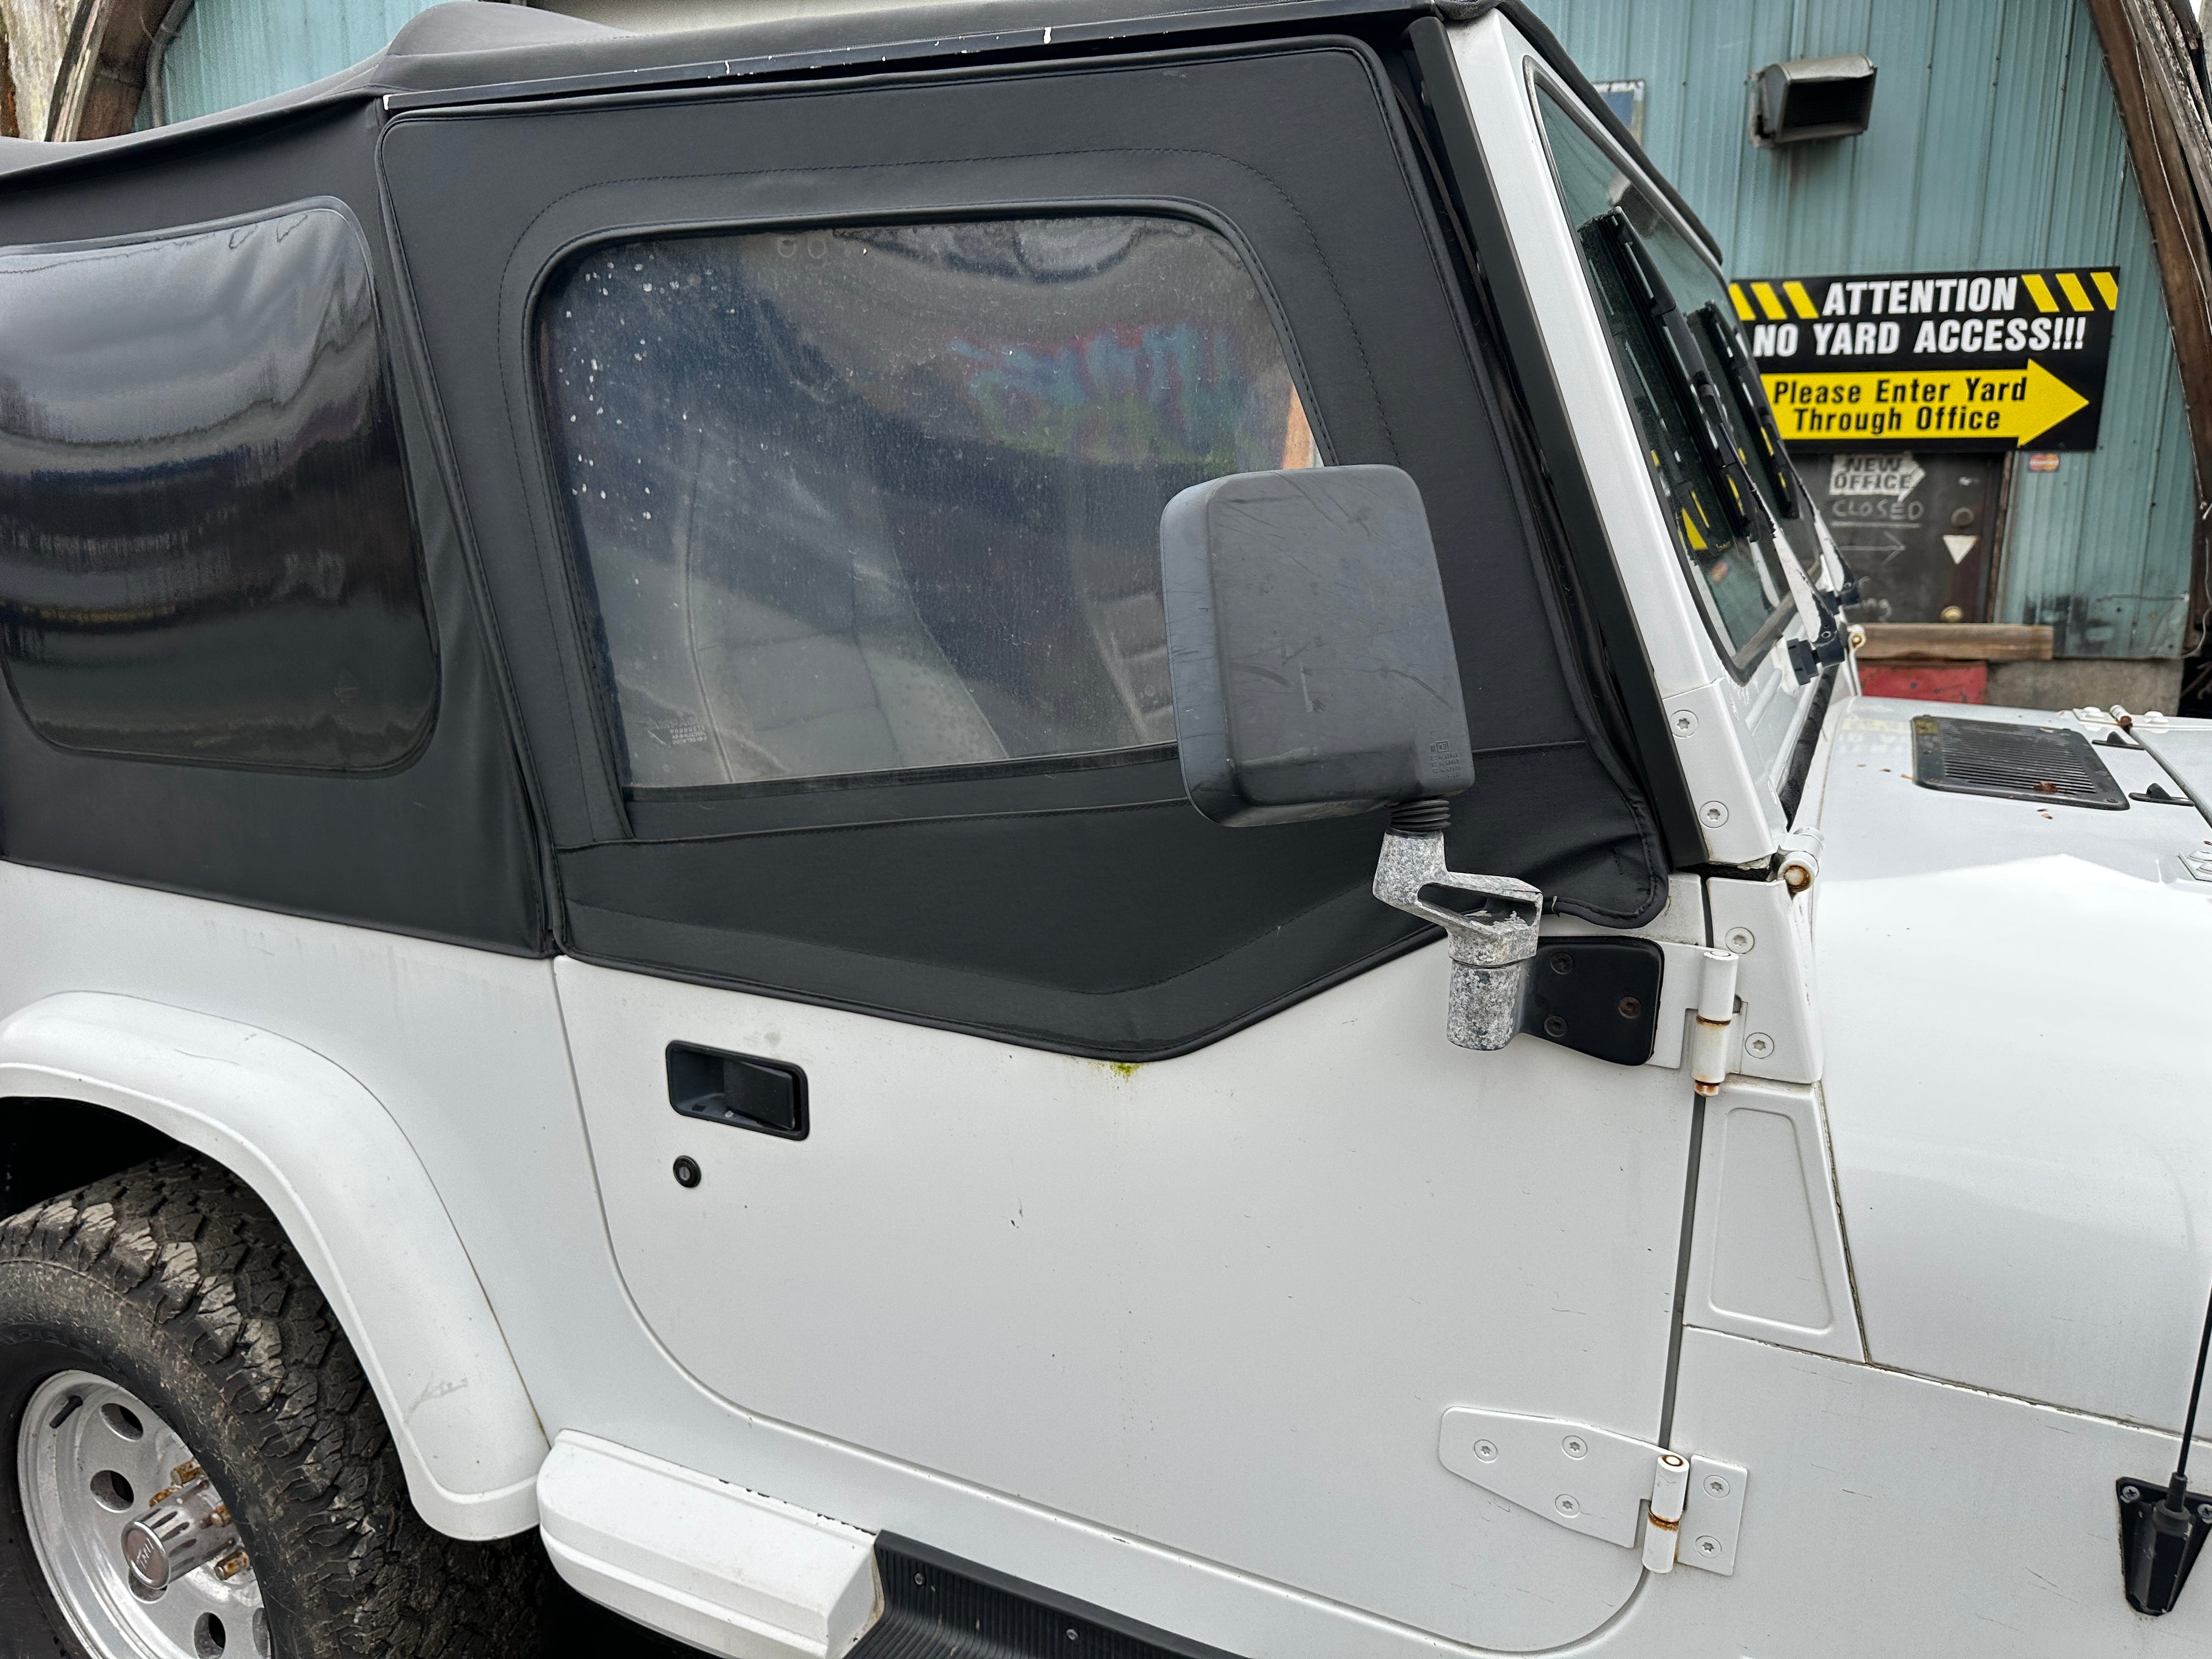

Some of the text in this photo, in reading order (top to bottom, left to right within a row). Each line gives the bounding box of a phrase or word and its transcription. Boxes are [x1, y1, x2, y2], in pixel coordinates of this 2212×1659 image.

[1822, 277, 2017, 316] ATTENTION
[1753, 317, 2086, 357] NO YARD ACCESS!!!
[1774, 376, 2027, 404] Please Enter Yard
[1794, 406, 2000, 435] Through Office
[1845, 457, 1900, 472] NEW
[1834, 472, 1913, 489] OFFICE
[1832, 498, 1924, 520] CLOSED
